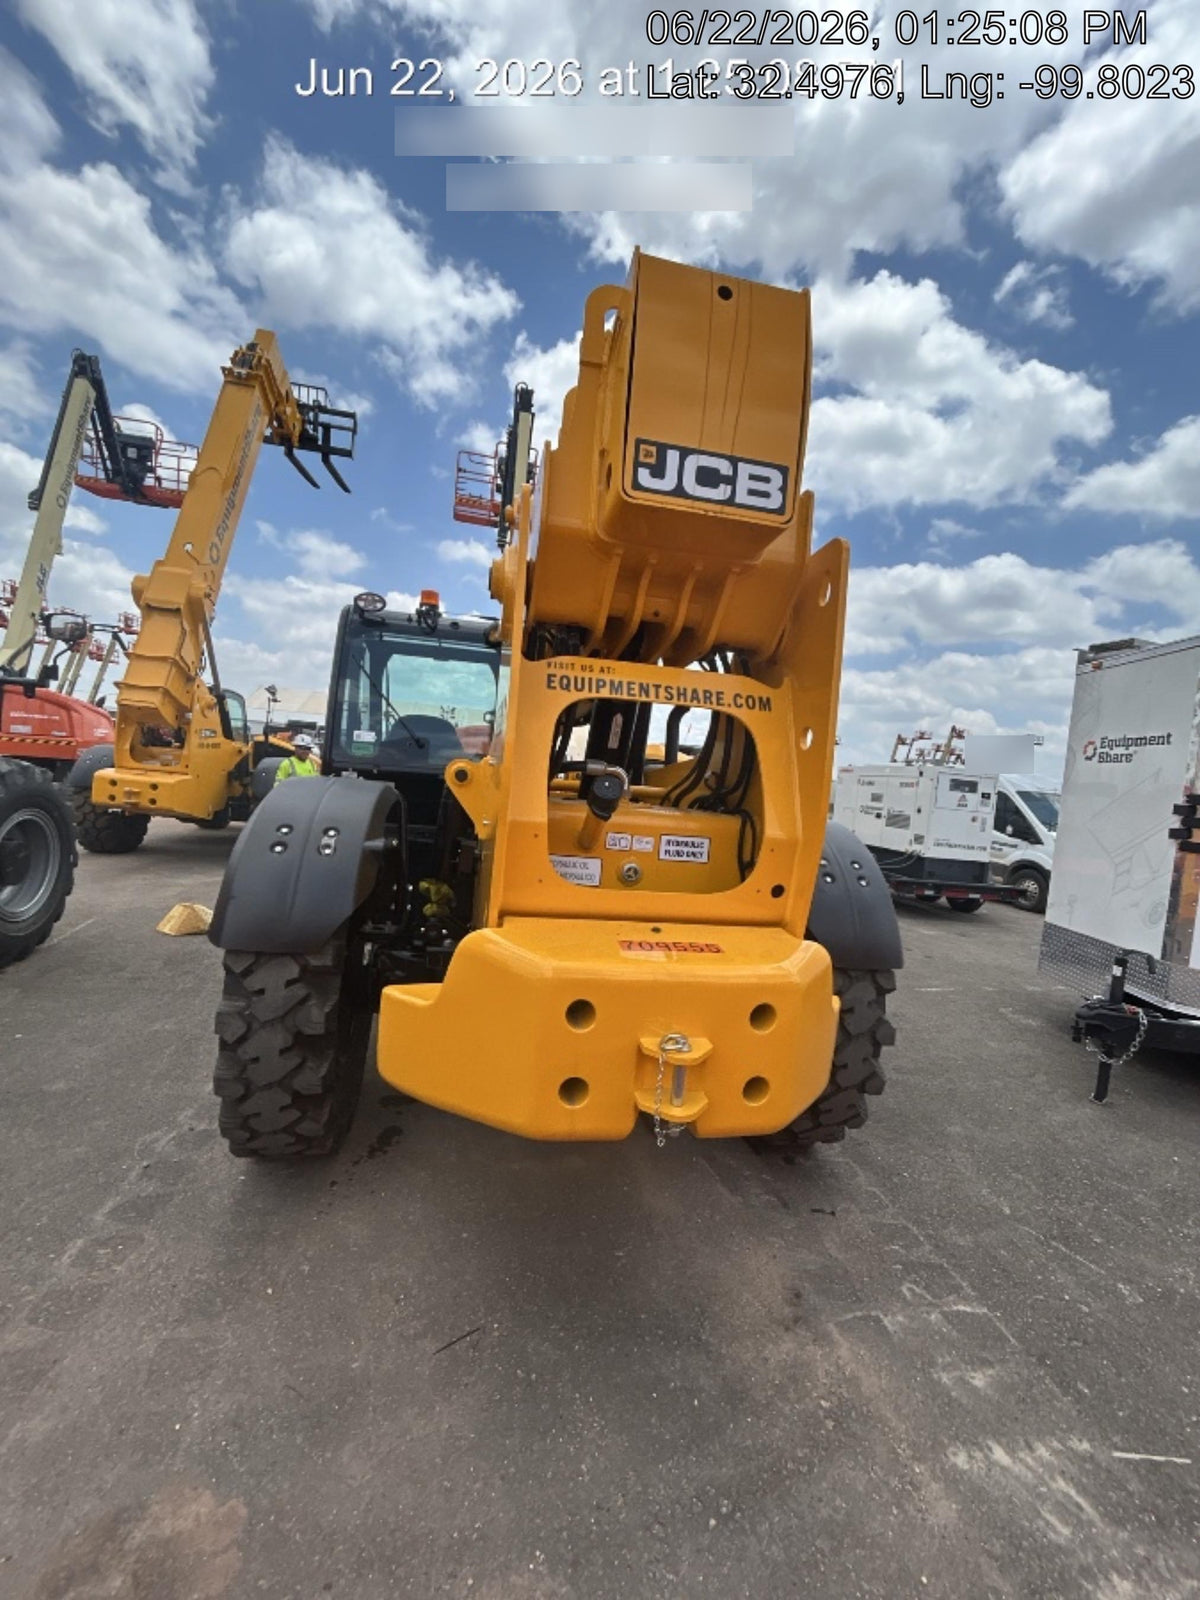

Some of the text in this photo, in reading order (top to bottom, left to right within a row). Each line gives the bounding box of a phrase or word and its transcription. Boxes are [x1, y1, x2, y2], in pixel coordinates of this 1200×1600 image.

[637, 449, 784, 510] JCB
[546, 661, 617, 675] VISIT US AT:
[546, 673, 772, 712] EQUIPMENTSHARE.COM
[1099, 732, 1173, 751] Equipment
